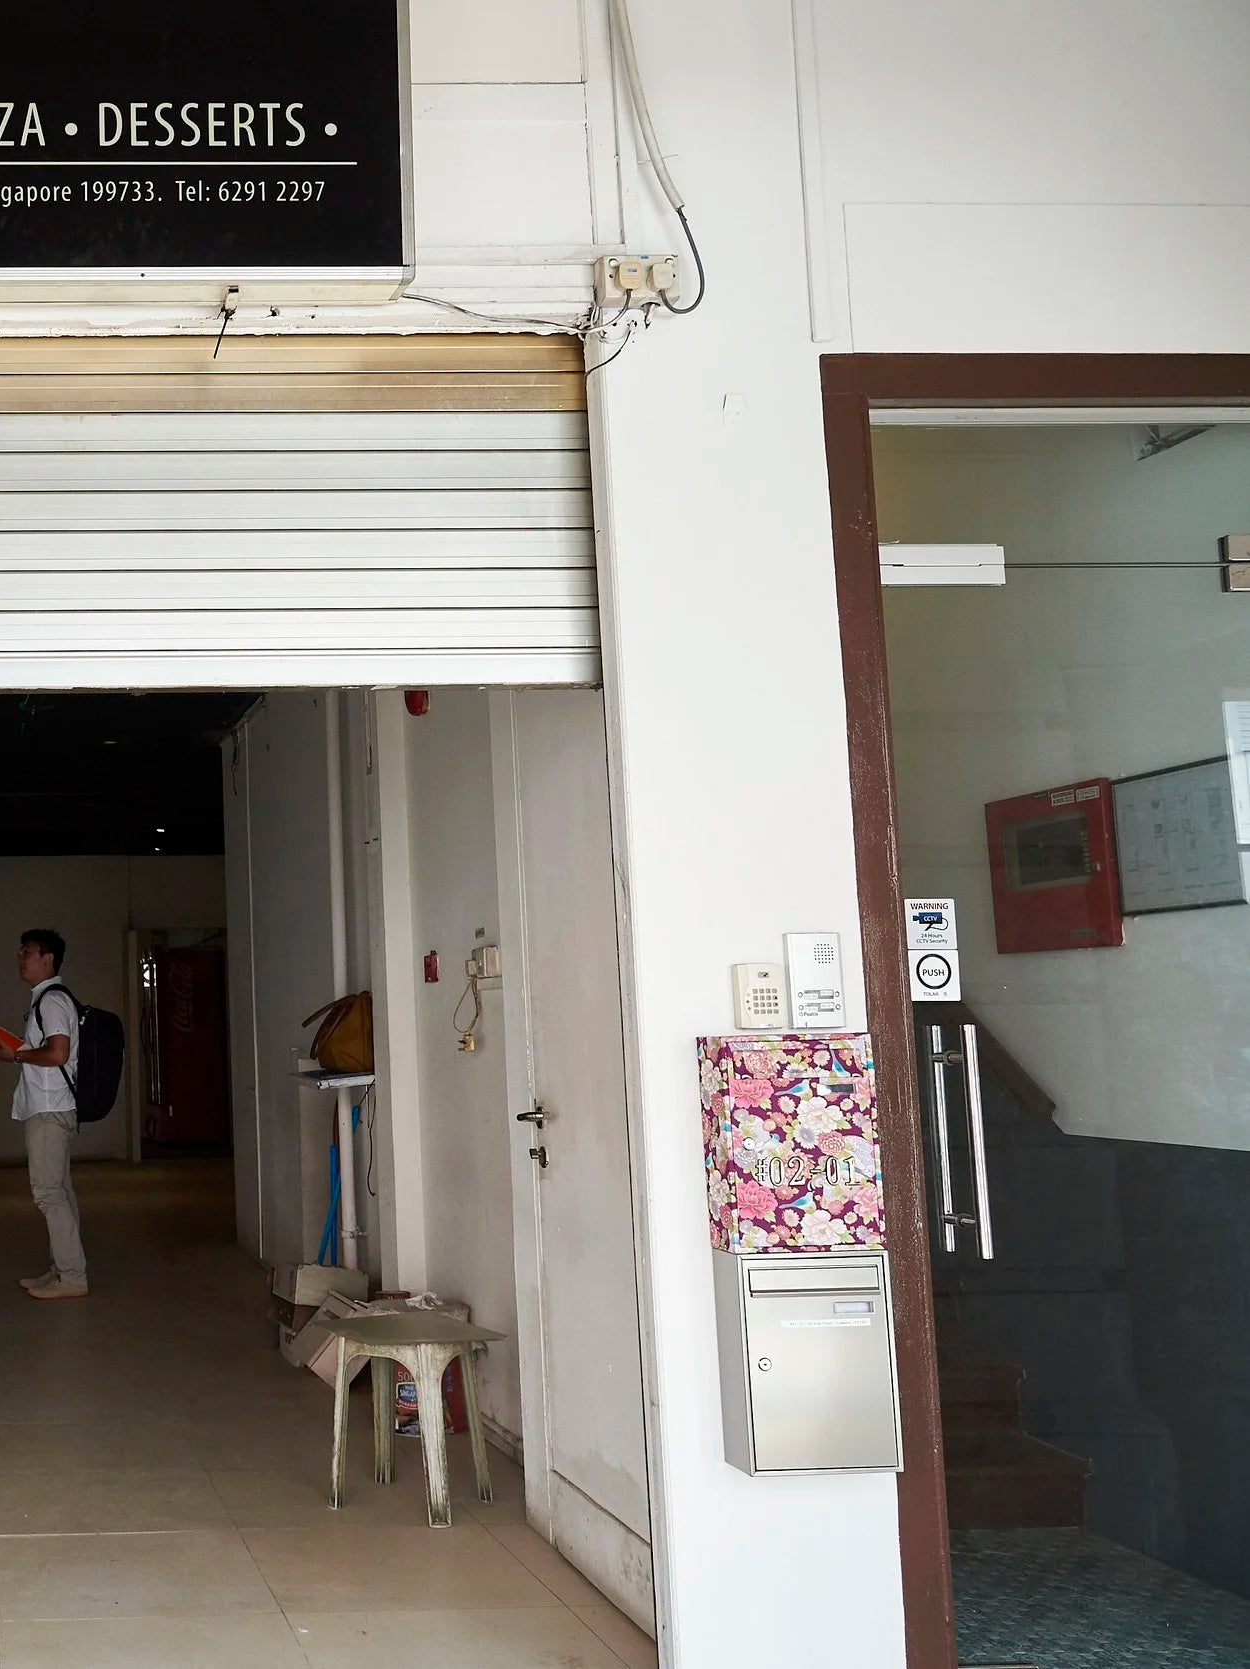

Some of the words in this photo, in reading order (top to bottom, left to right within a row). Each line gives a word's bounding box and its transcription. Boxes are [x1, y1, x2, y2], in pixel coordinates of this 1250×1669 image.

[98, 102, 306, 147] DESSERTS
[80, 180, 162, 203] 199733.
[175, 179, 210, 203] Tel:
[218, 180, 266, 203] 6291
[276, 180, 325, 203] 2297
[910, 902, 949, 910] WARNING
[922, 968, 945, 977] PUSH
[755, 1155, 861, 1187] #02-01
